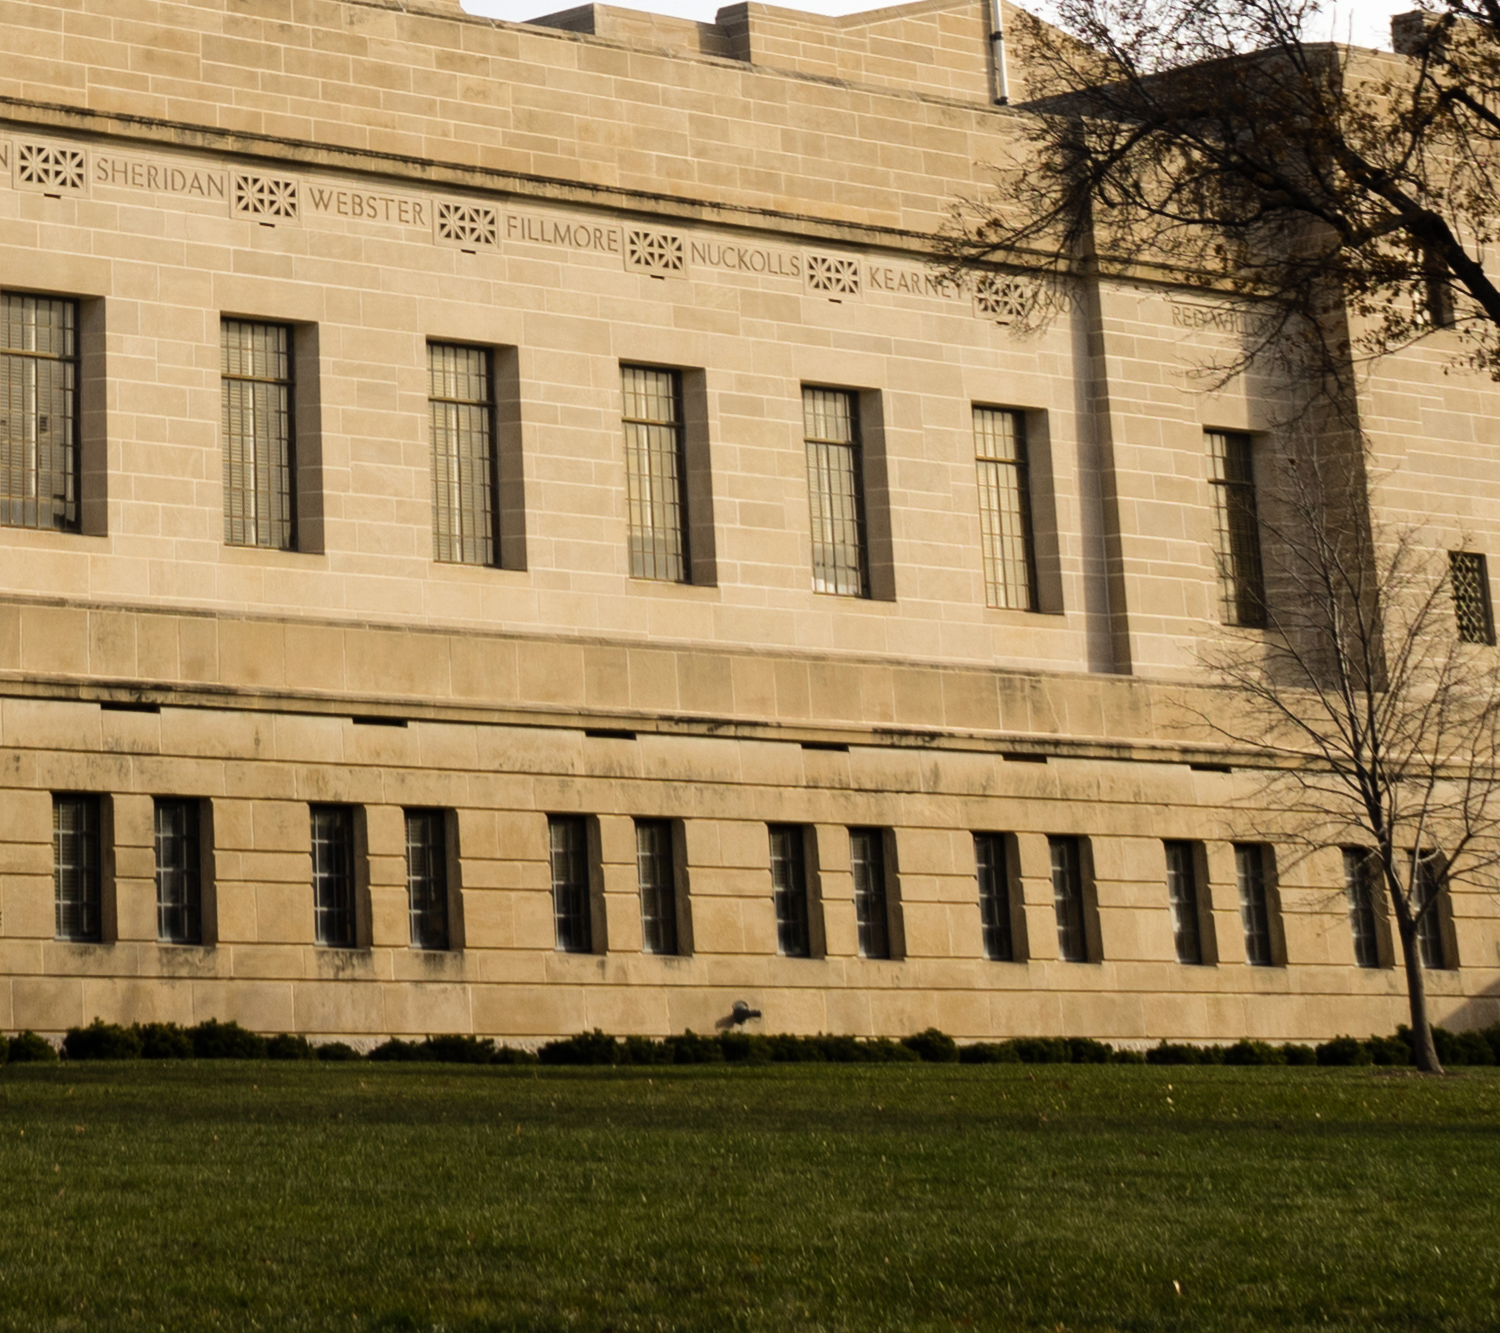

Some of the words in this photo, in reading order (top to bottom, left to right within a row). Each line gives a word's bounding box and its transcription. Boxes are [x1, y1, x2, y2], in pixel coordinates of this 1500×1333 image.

[96, 157, 225, 198] SHERIDAN
[309, 187, 427, 226] WEBSTER
[506, 215, 620, 253] FILLMORE
[691, 240, 801, 278] NUCKOLLS
[868, 266, 964, 300] KEARNEY
